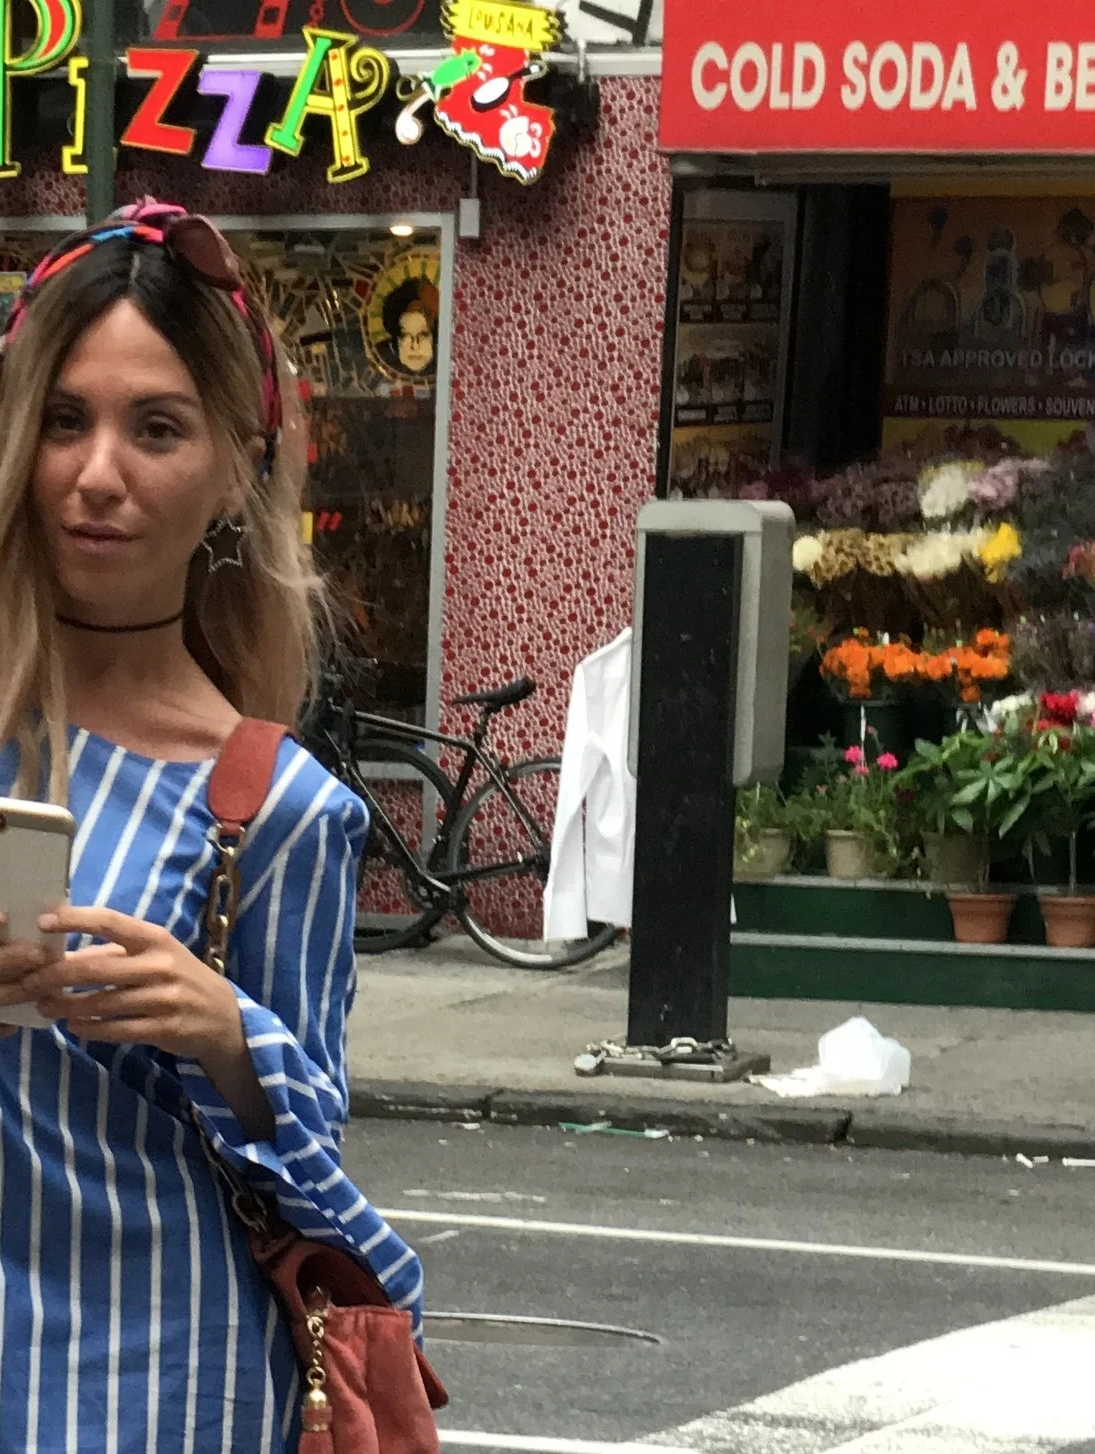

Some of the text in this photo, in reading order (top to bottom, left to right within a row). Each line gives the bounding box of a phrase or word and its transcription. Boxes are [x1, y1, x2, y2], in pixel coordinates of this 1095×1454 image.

[691, 39, 1095, 112] COLD SODA & BE
[938, 348, 1043, 369] APPROVED
[894, 395, 919, 413] ATM
[928, 395, 968, 415] LOTTO
[977, 395, 1035, 415] FLOWERS
